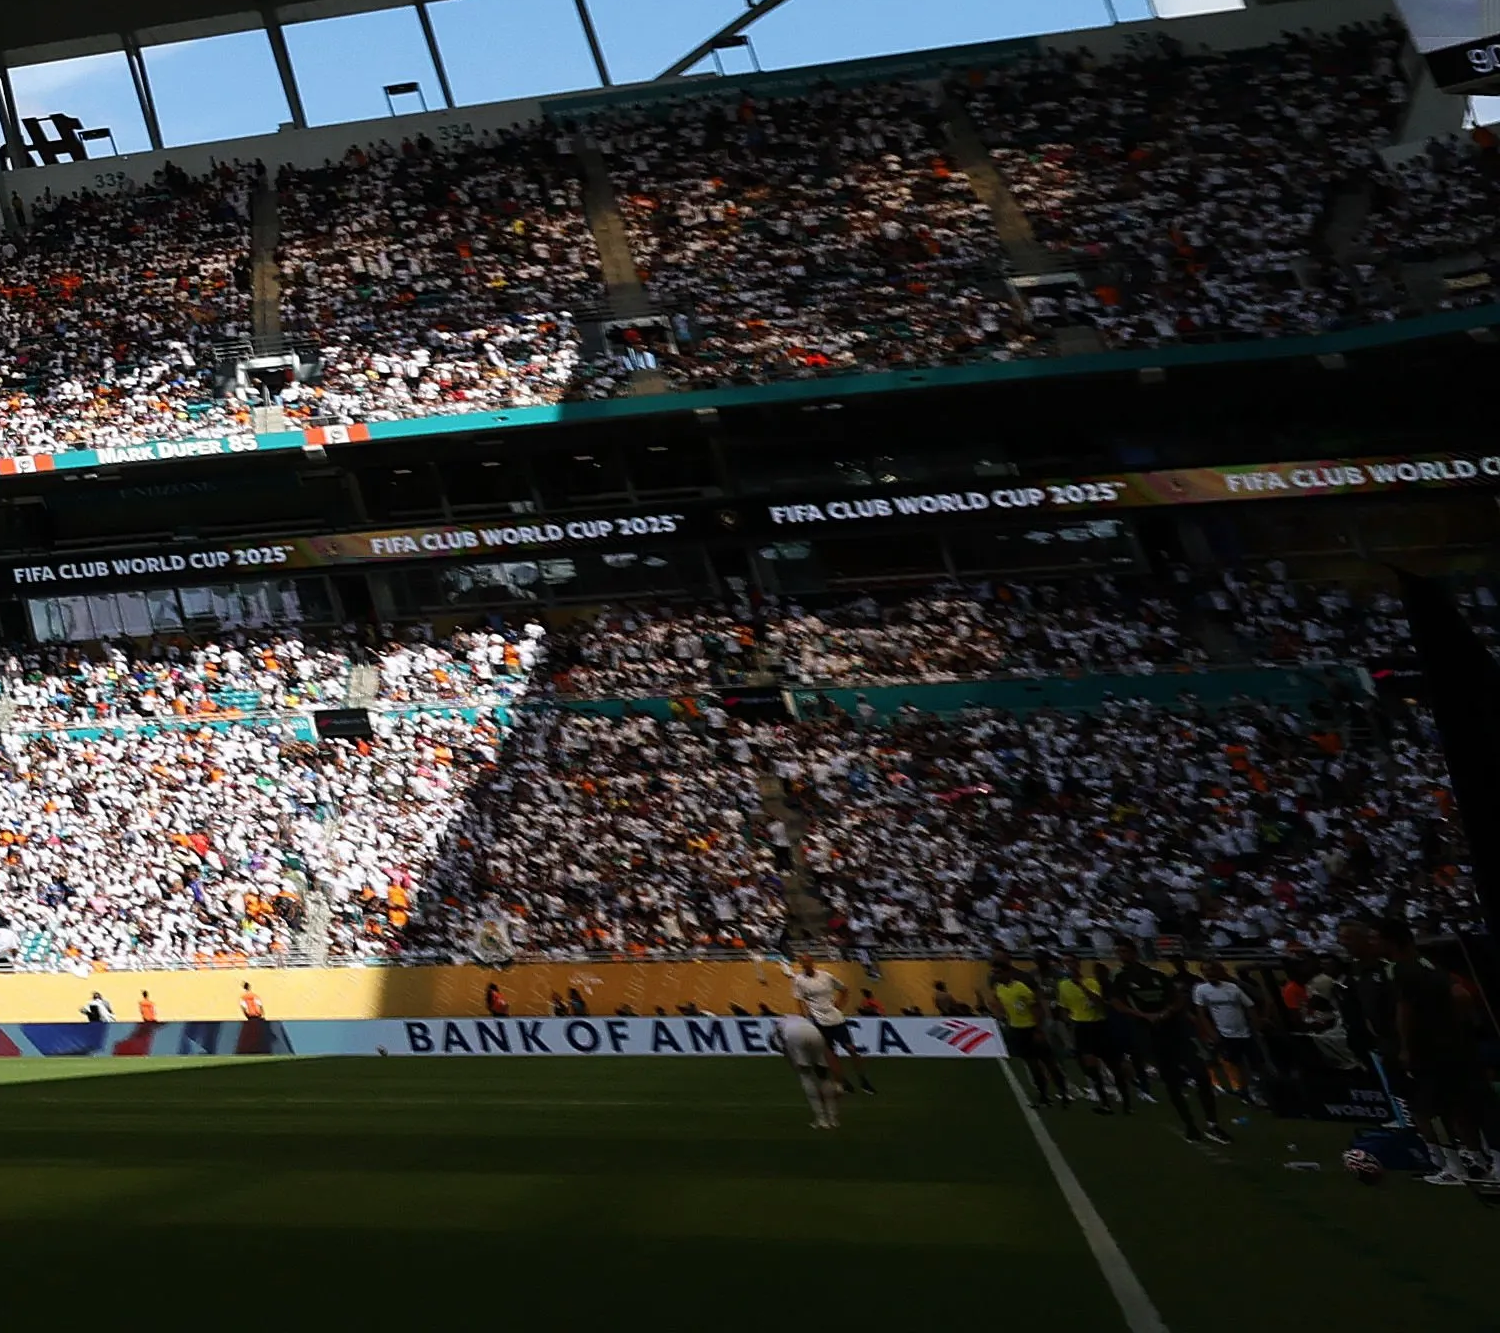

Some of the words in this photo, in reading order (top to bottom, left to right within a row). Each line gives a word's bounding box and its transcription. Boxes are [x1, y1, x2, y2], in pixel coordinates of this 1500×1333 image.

[97, 445, 156, 463] MARK
[158, 440, 223, 459] DUPER
[228, 433, 257, 451] 85
[770, 504, 826, 523] FIFA
[828, 499, 892, 519] CLUB
[893, 492, 988, 514] WORLD
[993, 488, 1044, 507] CUP
[14, 566, 54, 582] FIFA
[60, 561, 109, 578] CLUB
[112, 555, 185, 574] WORLD
[190, 551, 229, 568] CUP
[404, 1021, 560, 1054] BANK
[563, 1019, 630, 1053] OF
